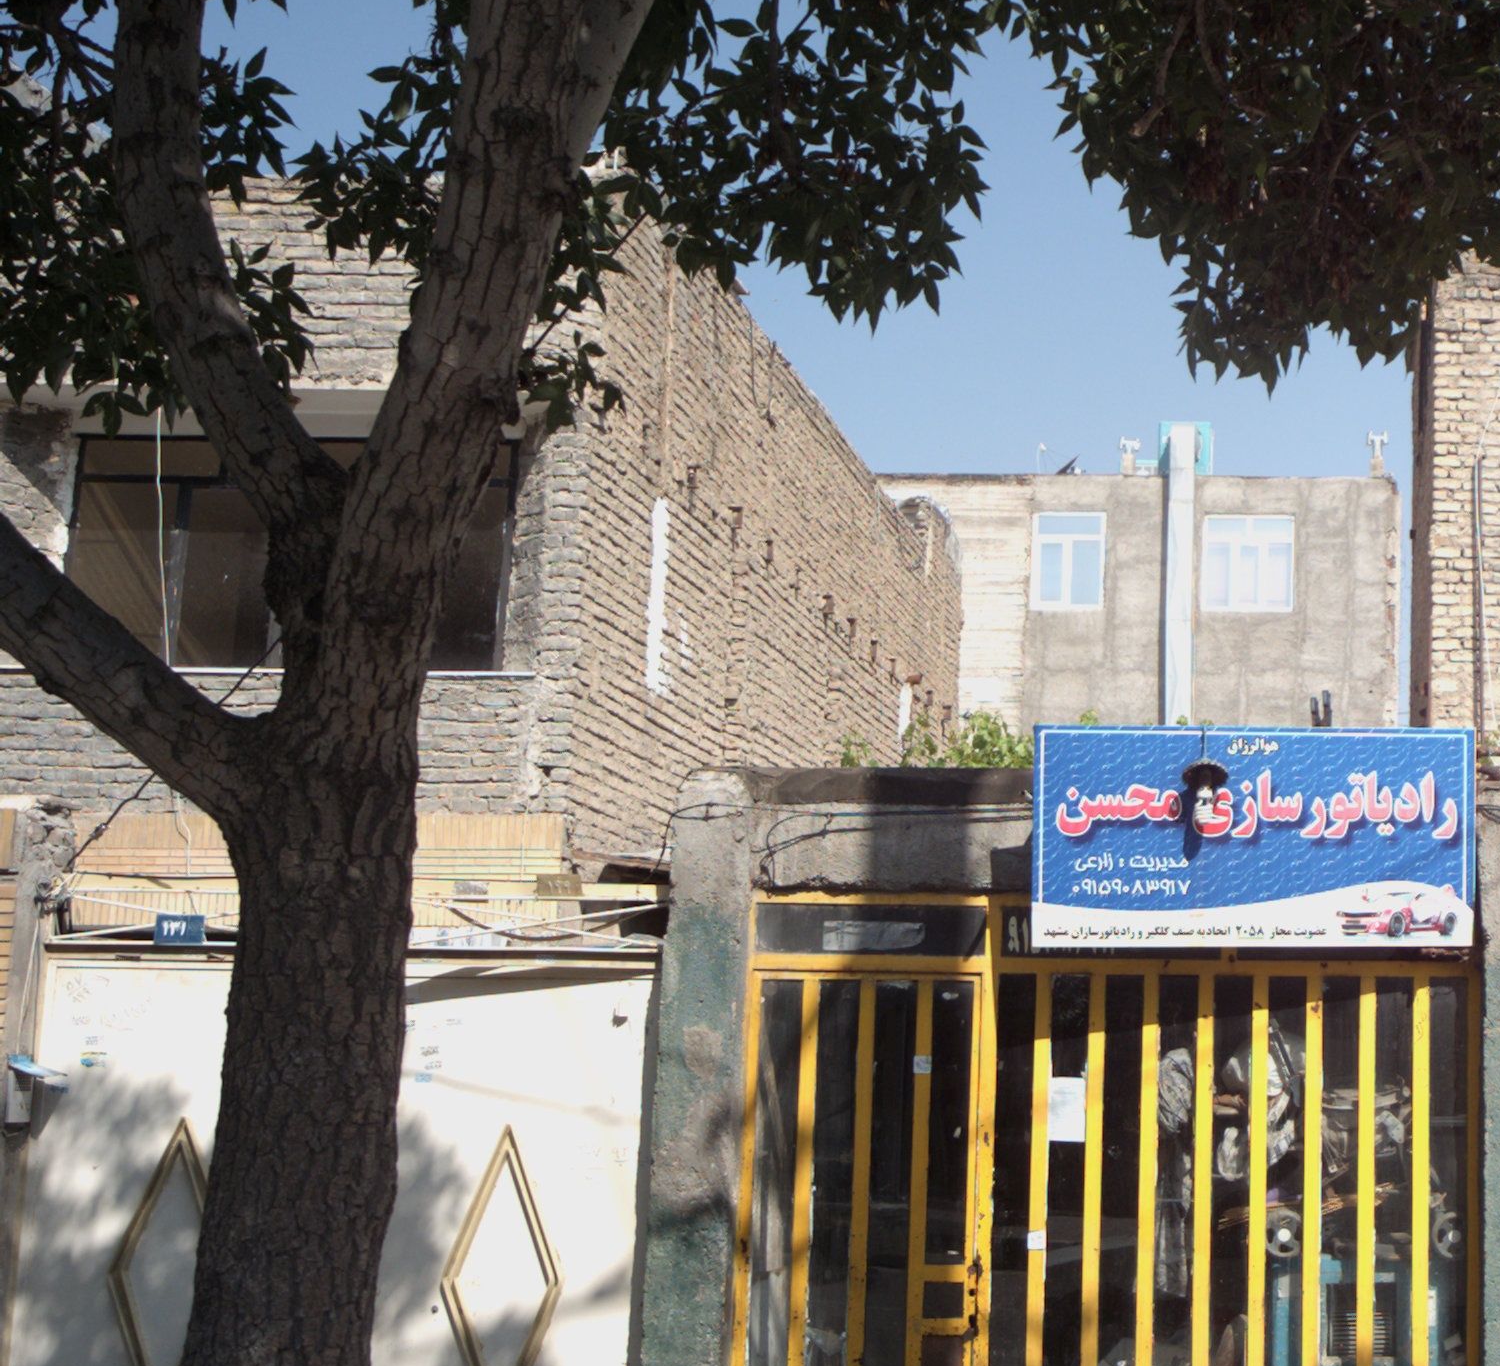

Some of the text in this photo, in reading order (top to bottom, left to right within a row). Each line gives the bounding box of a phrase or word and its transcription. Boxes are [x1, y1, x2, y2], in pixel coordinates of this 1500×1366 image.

[1056, 784, 1182, 837] محسن
[1074, 851, 1115, 872] زارعی
[1129, 854, 1190, 872] مدیریت
[1072, 878, 1191, 895] ۰۹۱۵۹۰۸۳۹۱۷
